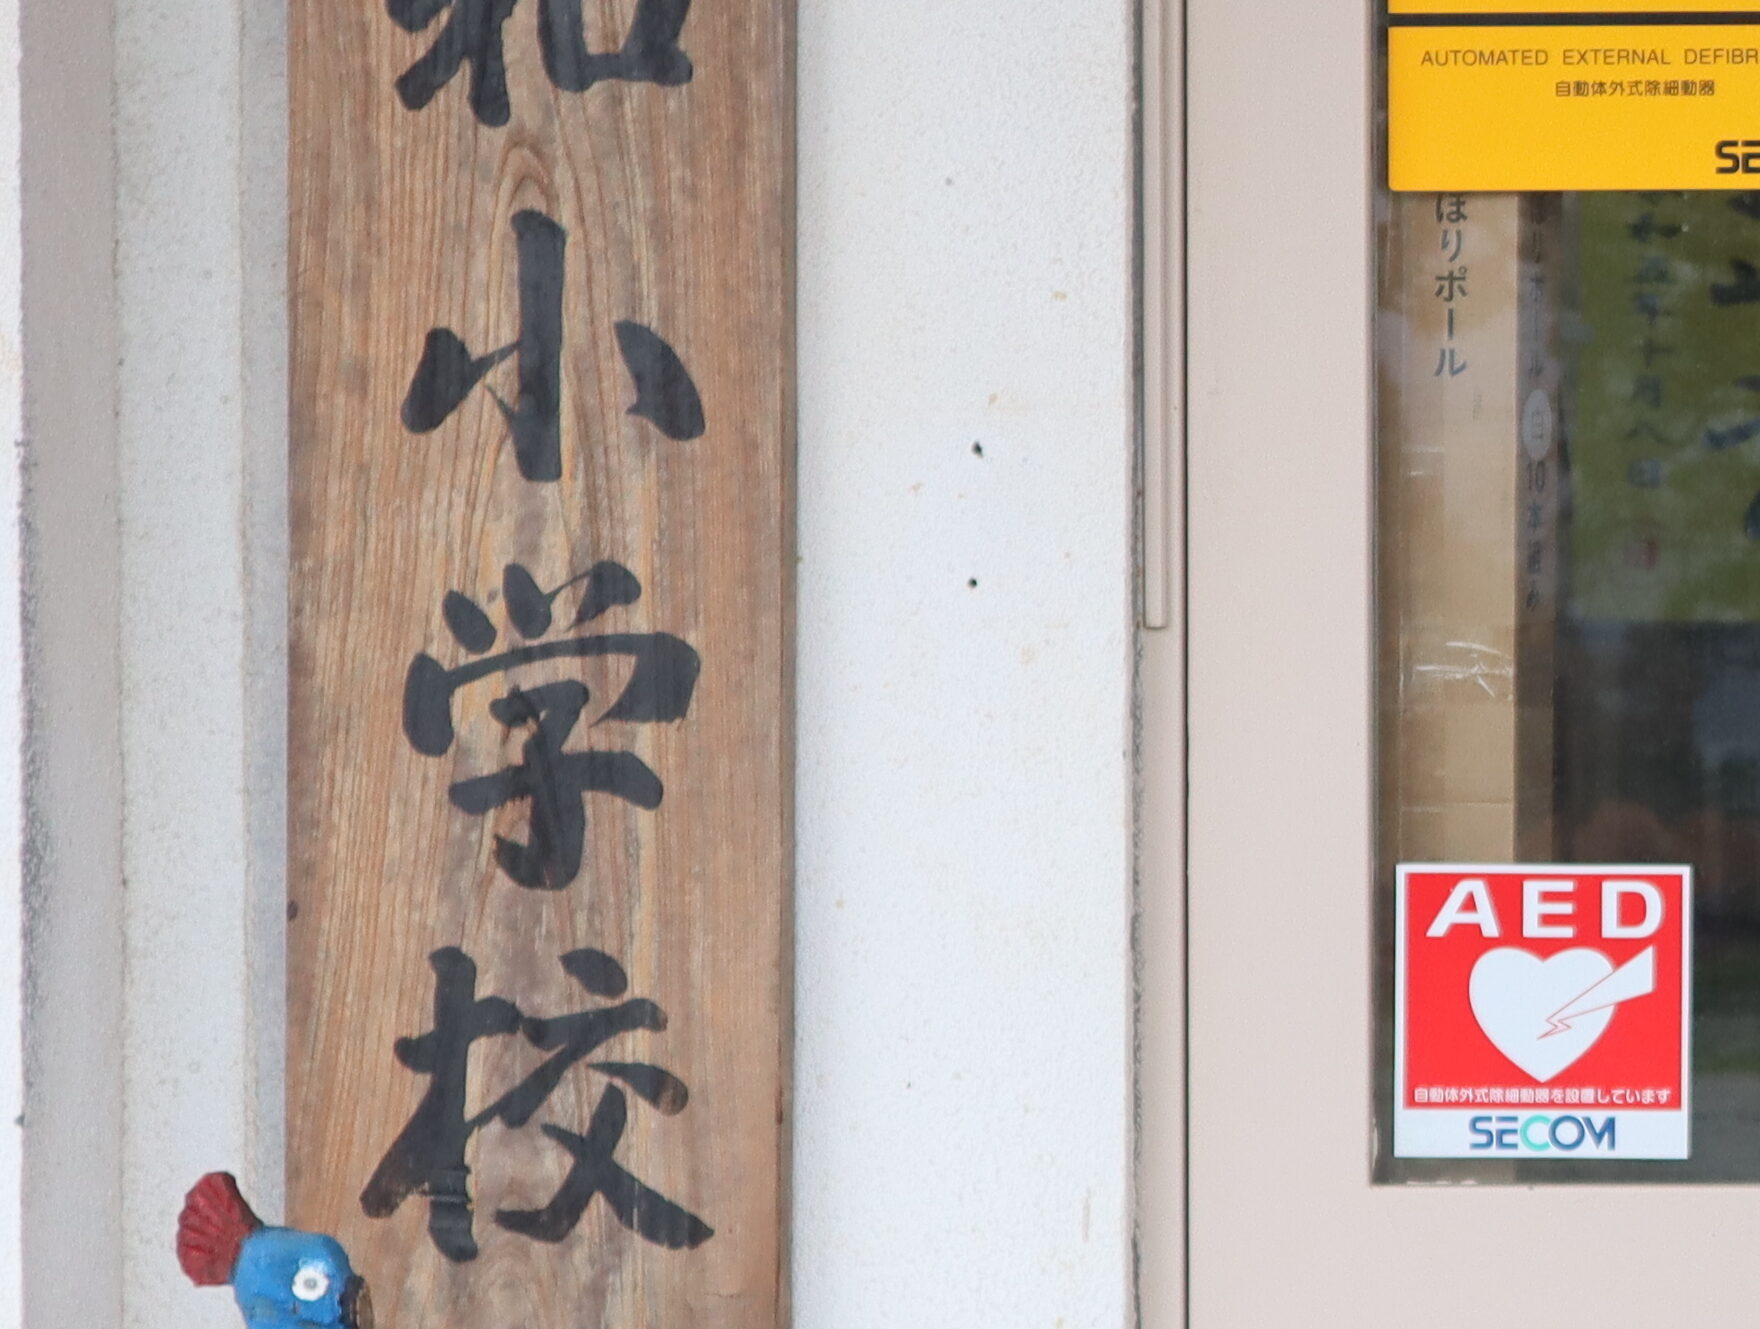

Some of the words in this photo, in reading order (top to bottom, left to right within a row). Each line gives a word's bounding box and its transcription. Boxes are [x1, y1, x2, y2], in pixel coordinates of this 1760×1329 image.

[1421, 49, 1549, 66] AUTOMATED
[1562, 49, 1671, 66] EXTERNAL
[1555, 80, 1716, 98] 自動体外式除細動器
[1425, 878, 1664, 938] AED
[1414, 1086, 1672, 1104] 自動体外式除細動器を設置しています
[1469, 1115, 1617, 1152] SECOM
